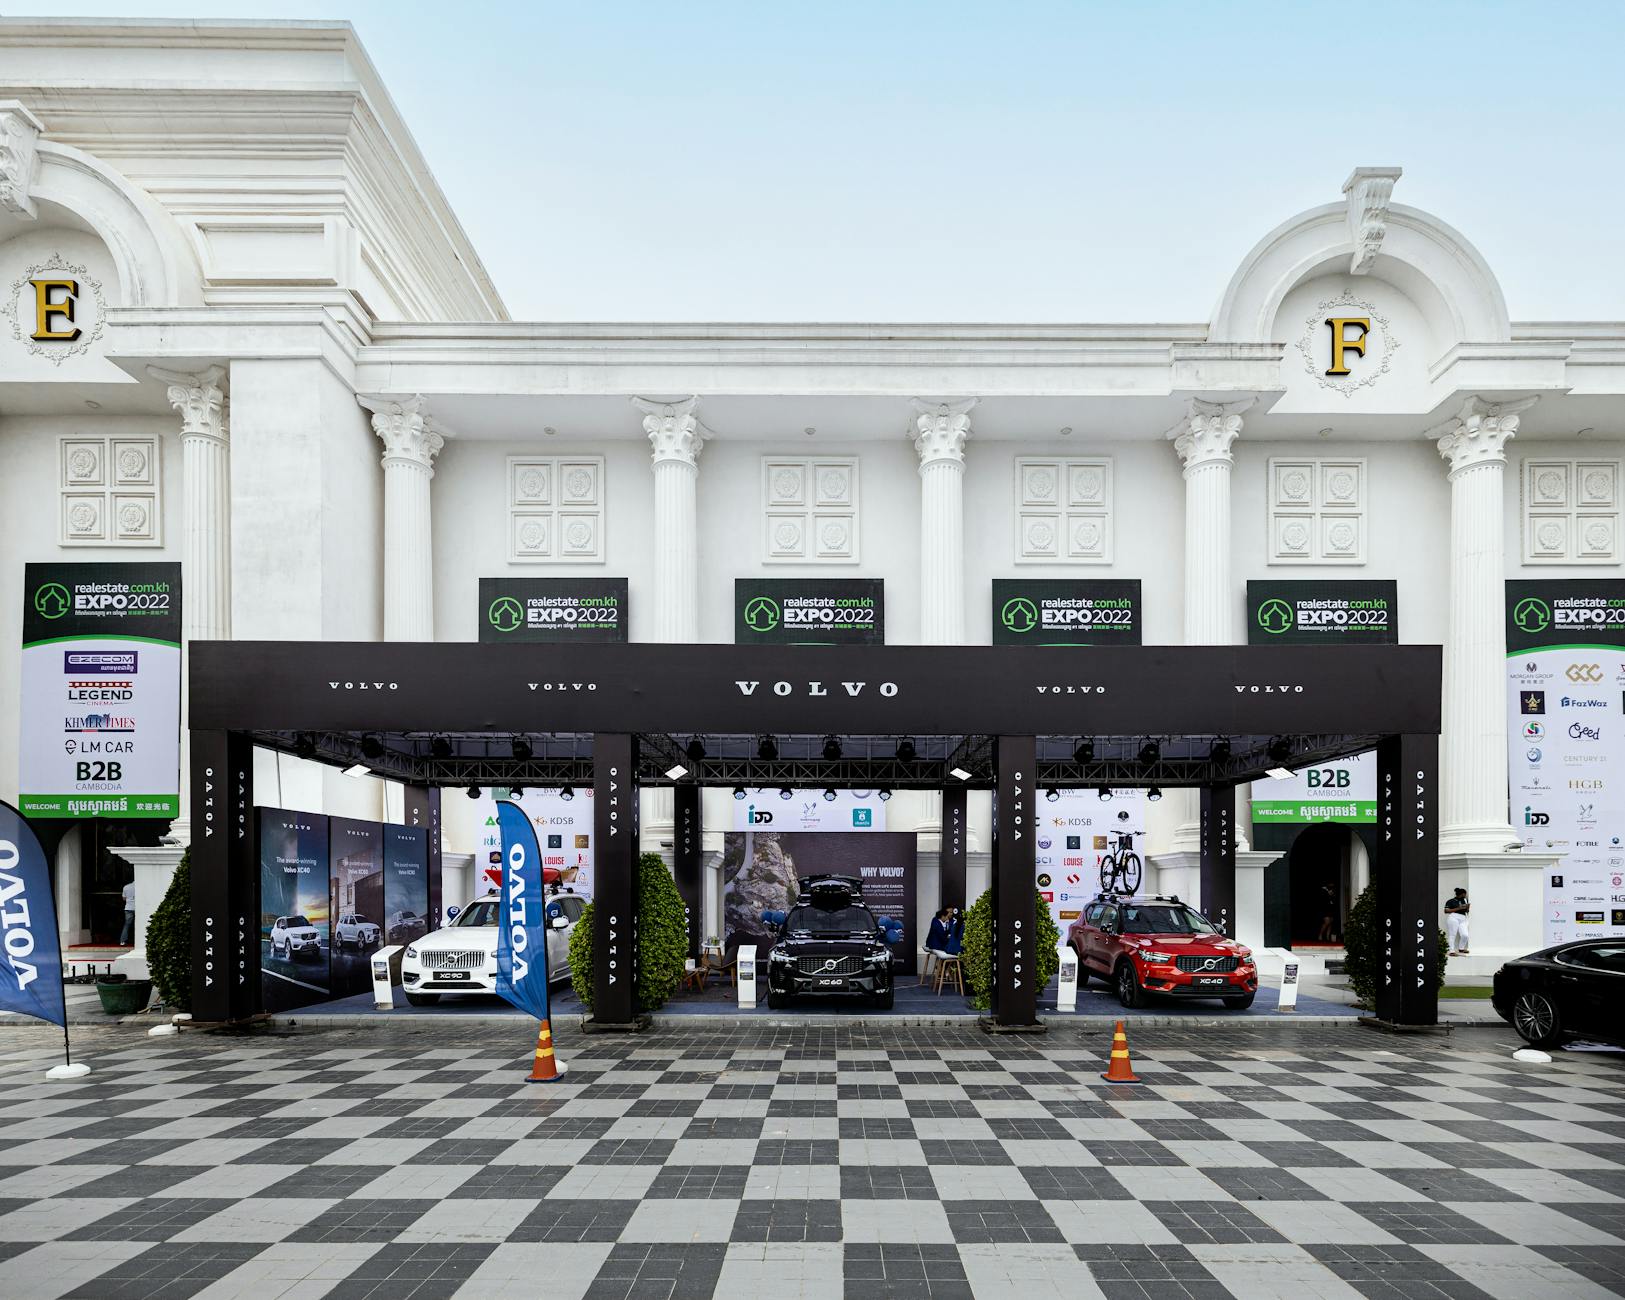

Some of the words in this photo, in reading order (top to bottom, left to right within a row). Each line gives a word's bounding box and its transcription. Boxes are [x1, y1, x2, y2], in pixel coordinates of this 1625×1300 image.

[29, 280, 82, 341] E
[1325, 317, 1371, 376] F
[75, 582, 169, 594] realestate.com.kh
[527, 597, 618, 607] realestate.com.kh
[783, 597, 874, 607] realestate.com.kh
[1041, 598, 1132, 608] realestate.com.kh
[1297, 599, 1387, 609] realestate.com.kh
[329, 682, 398, 690] VOLVO
[528, 683, 597, 691] VOLVO
[736, 681, 899, 697] VOLVO
[1036, 686, 1105, 694] VOLVO
[1235, 685, 1304, 693] VOLVO
[68, 690, 133, 700] LEGEND
[65, 717, 102, 728] KHMER
[104, 717, 136, 728] TIMES
[81, 741, 101, 752] LM
[105, 741, 134, 752] CAR
[76, 761, 122, 781] B2B
[1307, 768, 1351, 787] B2B
[205, 767, 213, 838] VOLVO
[610, 767, 618, 837] VOLVO
[1014, 771, 1022, 841] VOLVO
[1416, 770, 1425, 840] VOLVO
[549, 816, 574, 825] KDSB
[1068, 817, 1092, 826] KDSB
[282, 822, 311, 831] VOLVO
[347, 829, 369, 837] VOLVO
[544, 856, 565, 866] LOUISE
[1063, 857, 1084, 867] LOUISE
[283, 866, 297, 874] Volvo
[860, 867, 878, 877] WHY
[878, 867, 904, 878] VOLVO?
[509, 843, 529, 985] VOLVO
[205, 917, 213, 987] VOLVO
[609, 915, 617, 985] VOLVO
[1014, 920, 1022, 989] VOLVO
[1416, 918, 1425, 988] VOLVO
